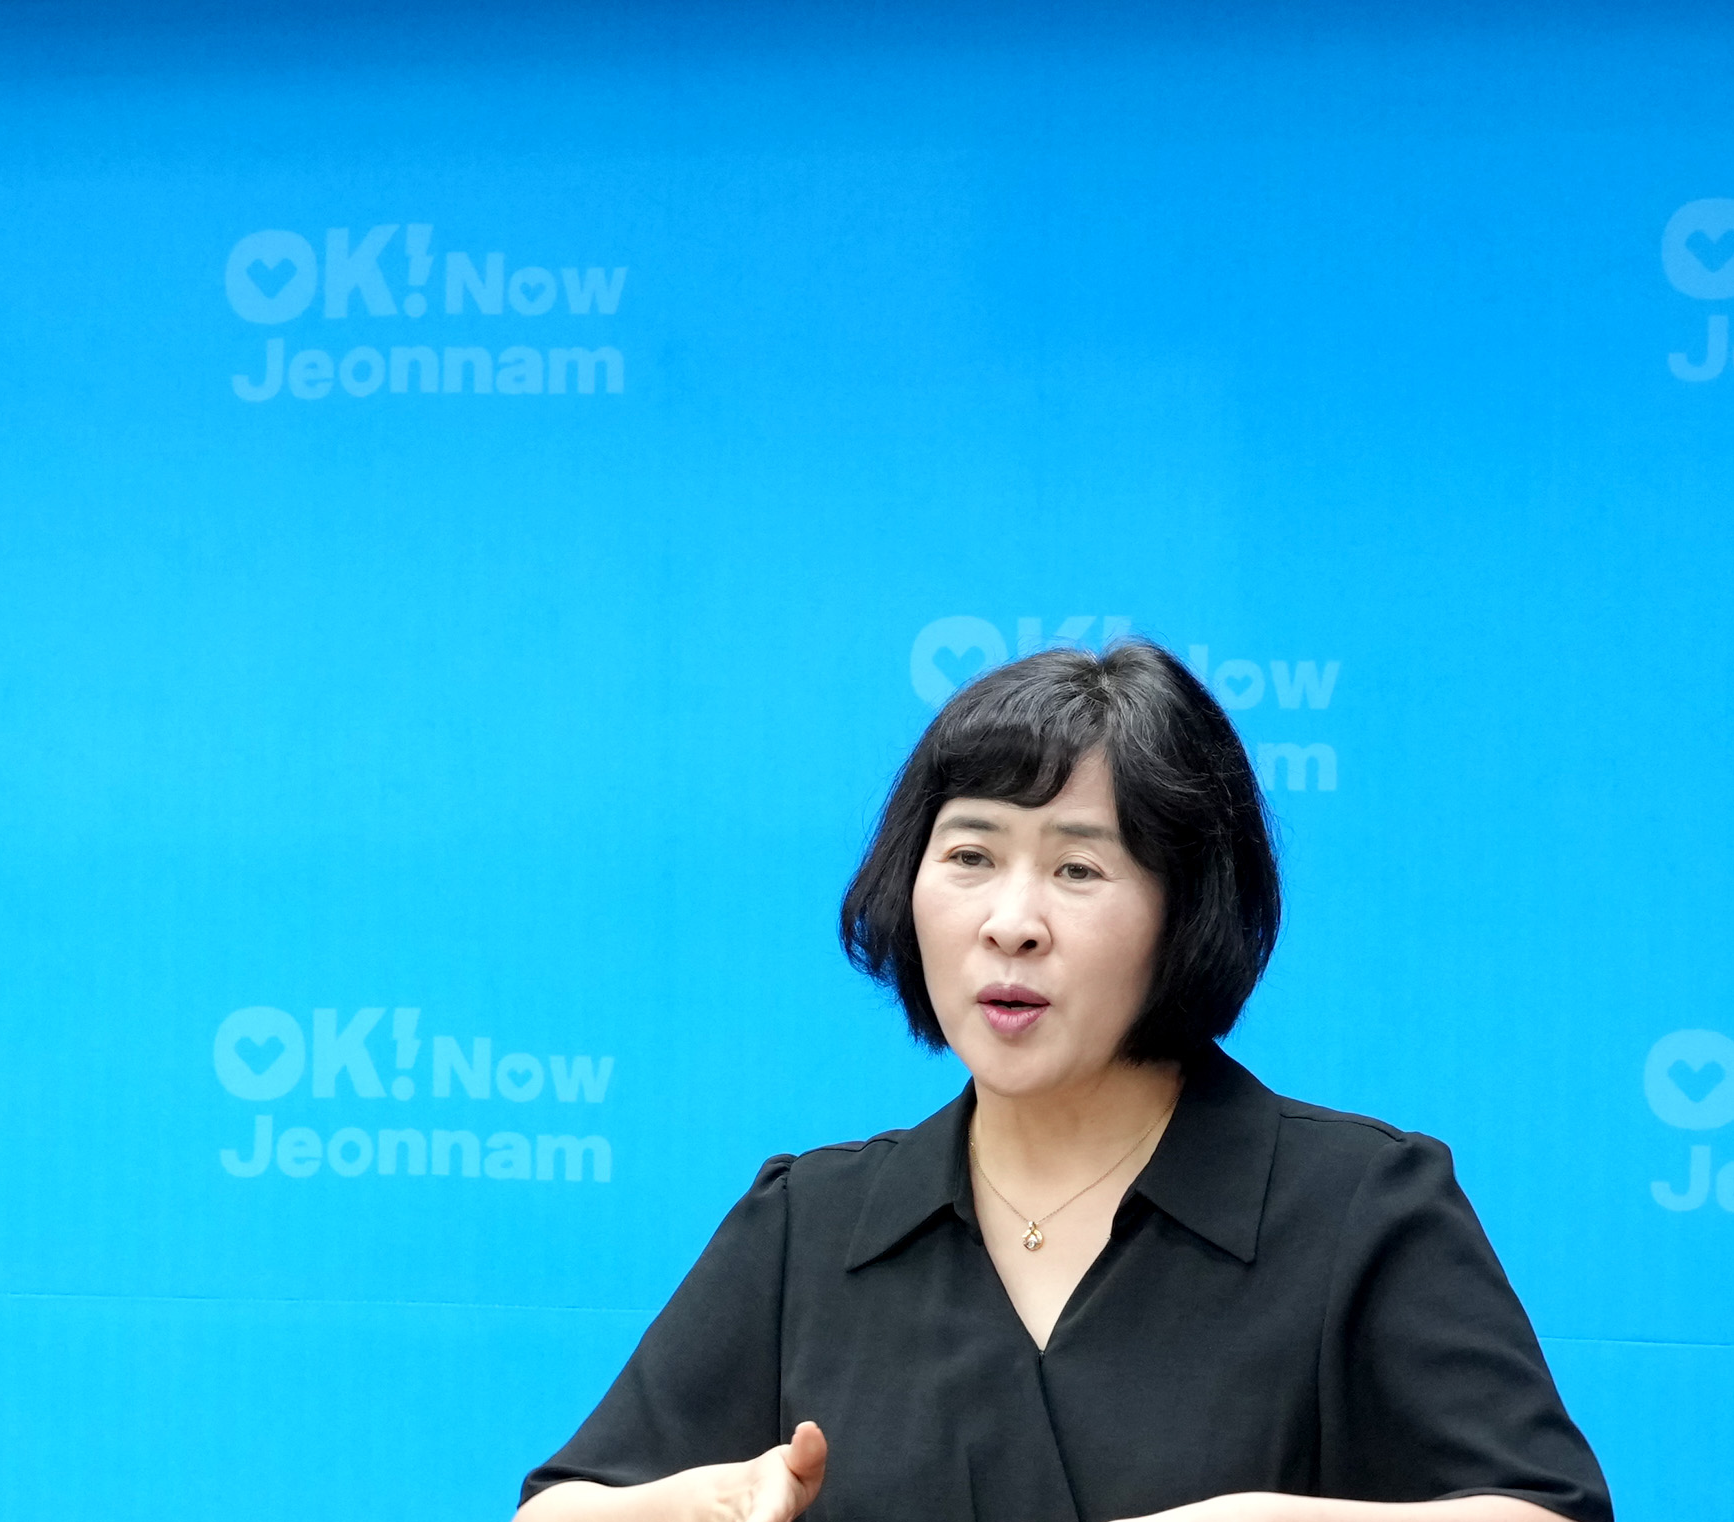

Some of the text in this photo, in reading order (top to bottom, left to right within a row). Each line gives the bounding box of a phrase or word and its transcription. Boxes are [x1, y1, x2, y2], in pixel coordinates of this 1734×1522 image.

[446, 251, 628, 315] Now
[232, 338, 625, 401] Jeonnam
[1189, 643, 1340, 711] ow
[433, 1034, 615, 1106] Now
[220, 1115, 613, 1185] Jeonnam
